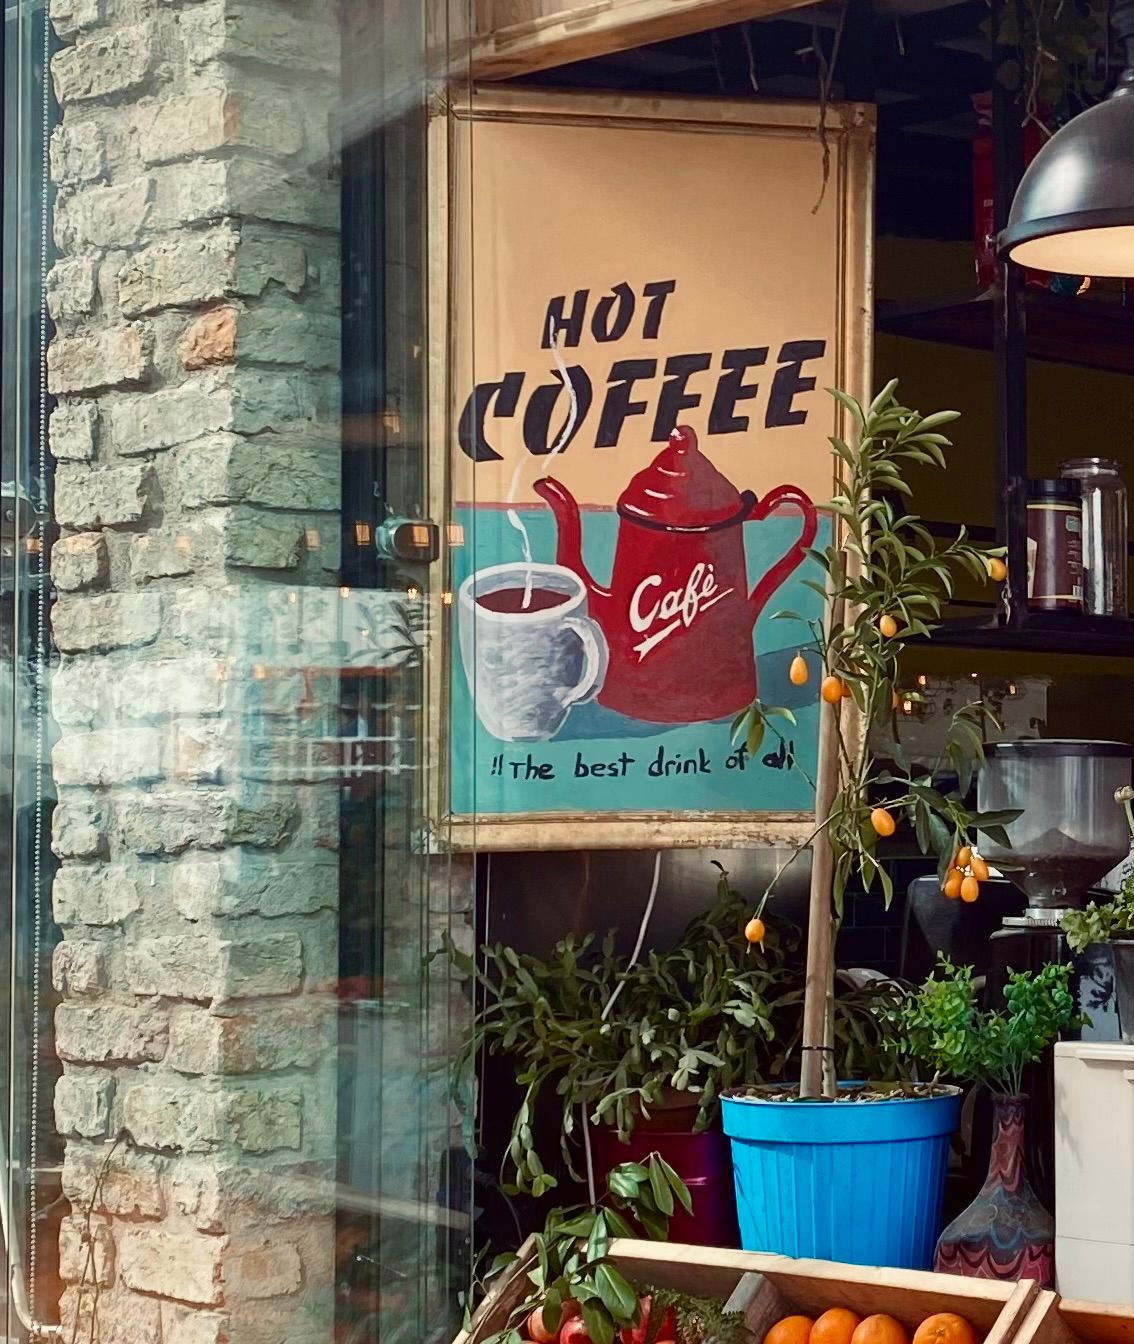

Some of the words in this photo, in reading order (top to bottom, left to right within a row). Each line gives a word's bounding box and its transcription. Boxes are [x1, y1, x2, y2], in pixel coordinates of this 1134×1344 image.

[541, 279, 676, 349] HOT
[458, 340, 827, 462] COFFEE
[574, 752, 636, 777] best
[648, 745, 711, 777] drink
[725, 741, 749, 770] of
